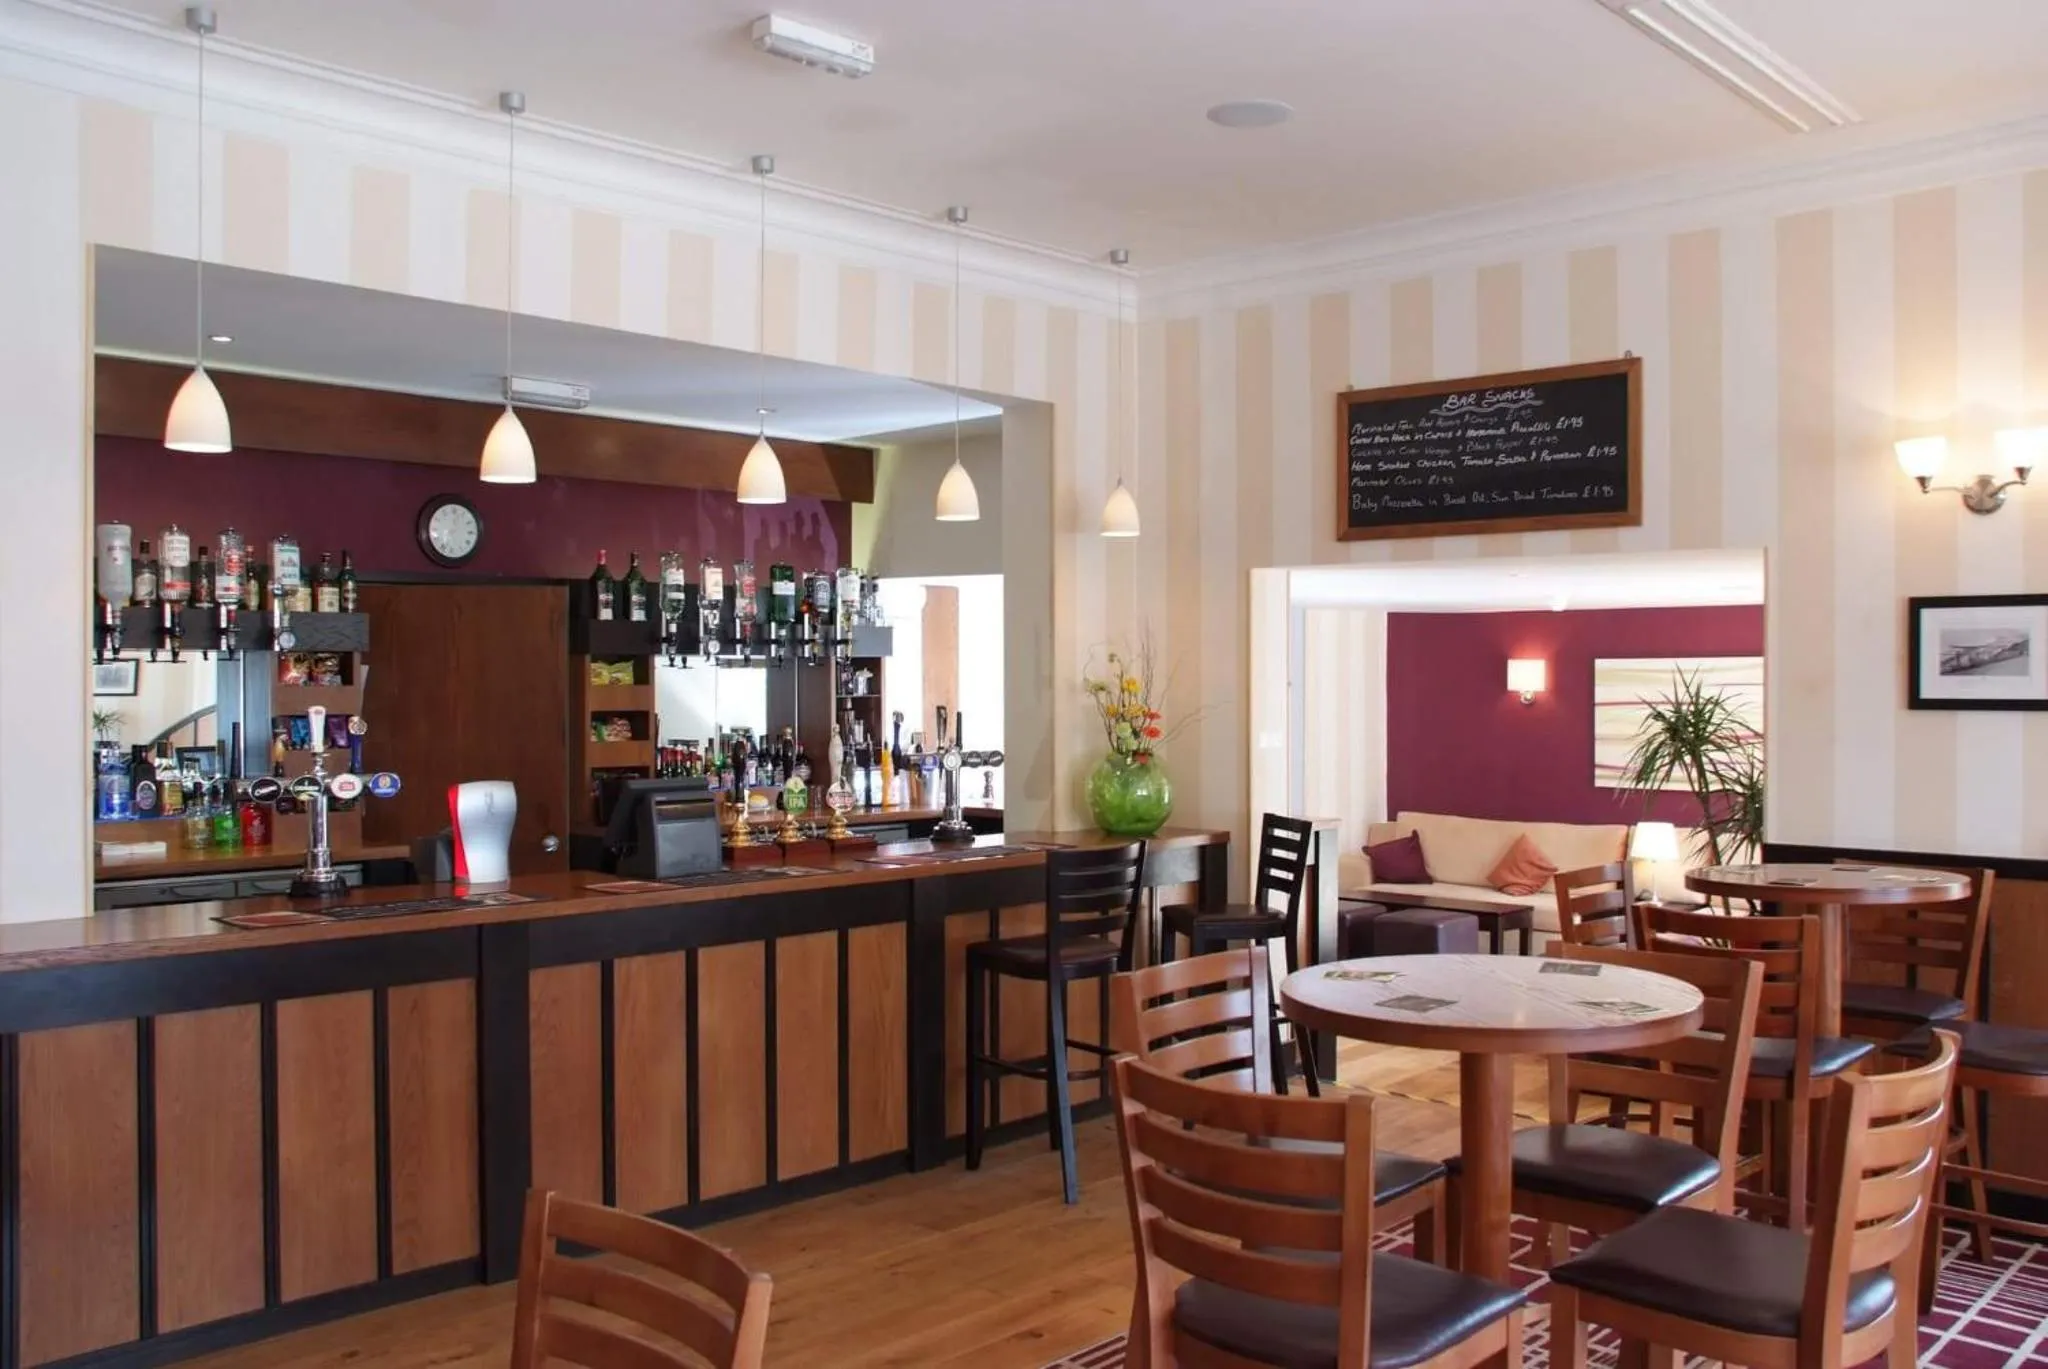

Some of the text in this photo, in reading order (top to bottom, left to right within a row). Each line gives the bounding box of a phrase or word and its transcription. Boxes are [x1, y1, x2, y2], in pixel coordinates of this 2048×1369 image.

[1442, 388, 1536, 411] BAR SNACKS
[1555, 416, 1584, 430] £1.95
[1586, 446, 1618, 458] £1.95
[1352, 494, 1378, 512] Baby
[1582, 485, 1614, 499] £1.95
